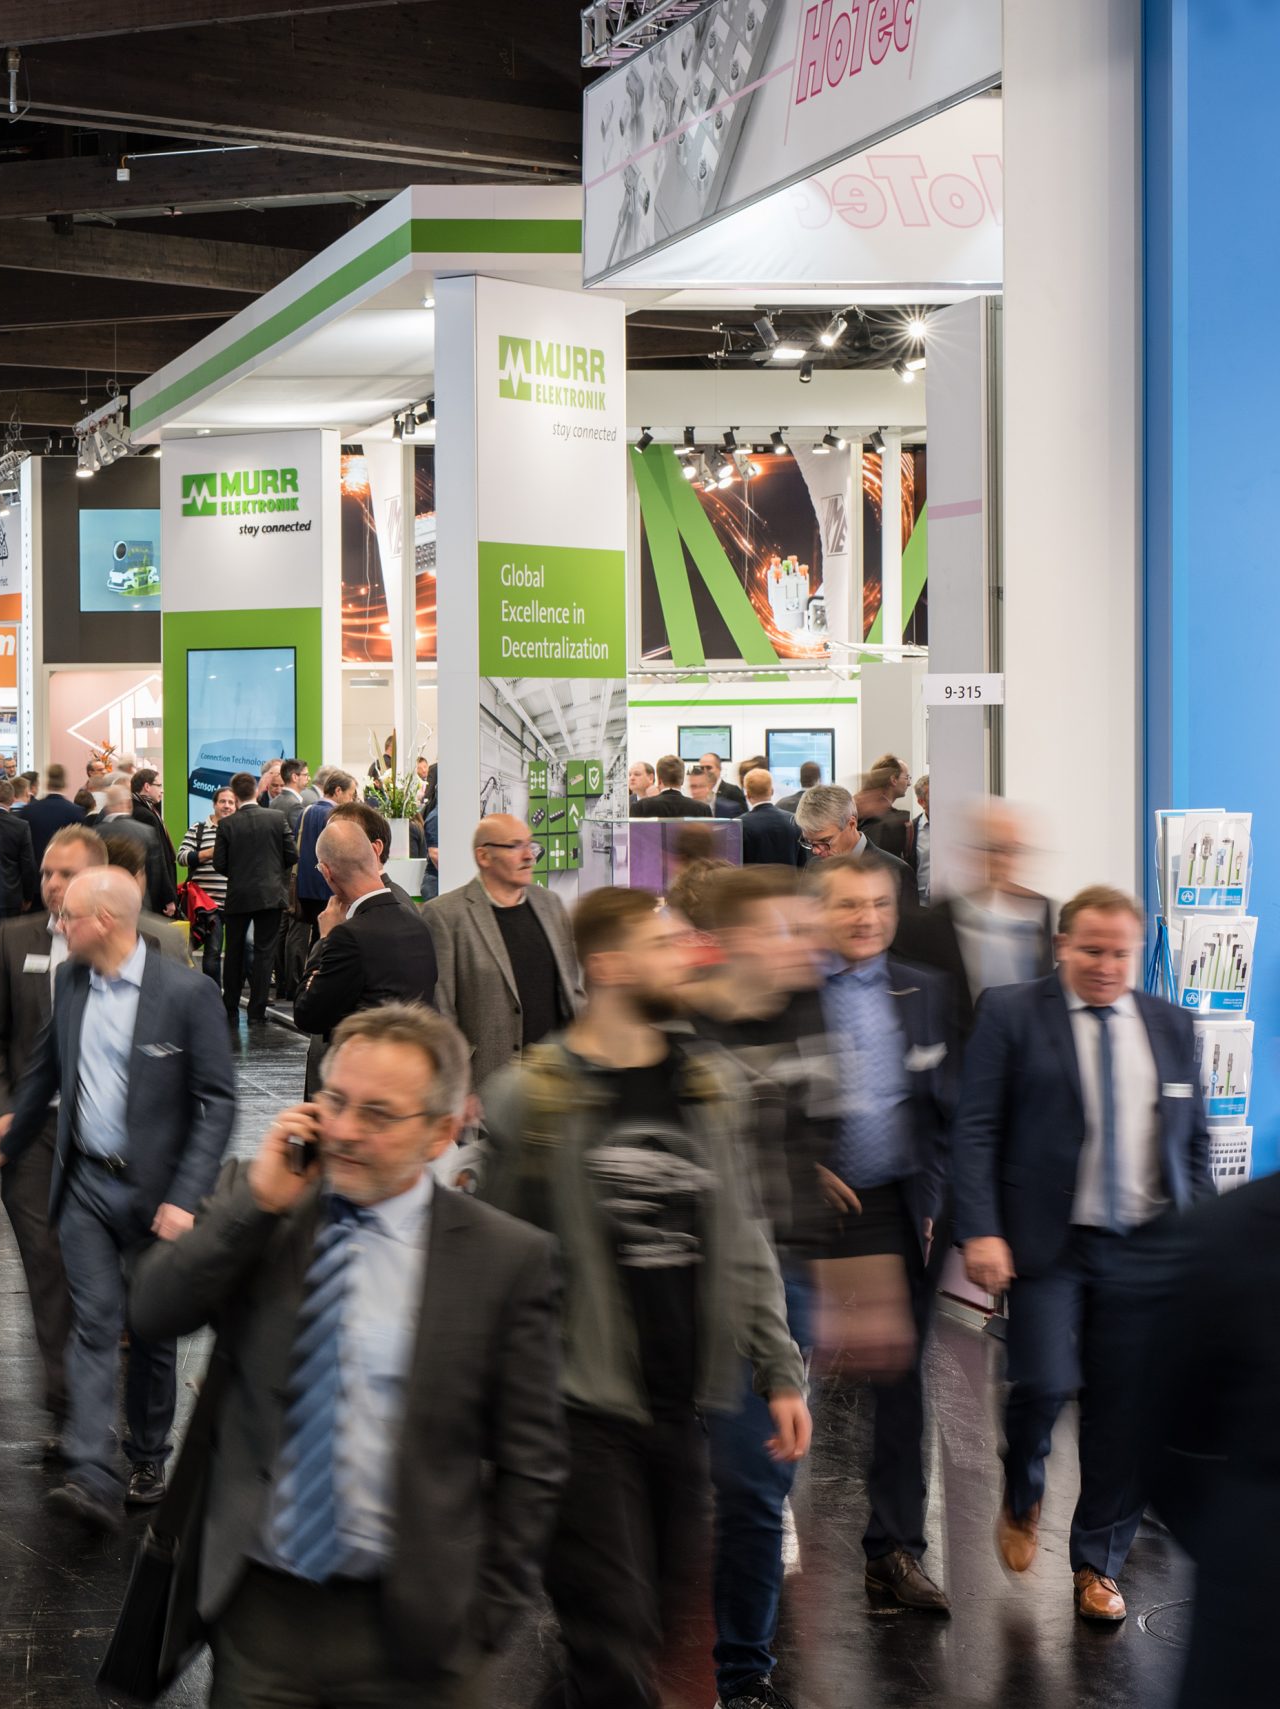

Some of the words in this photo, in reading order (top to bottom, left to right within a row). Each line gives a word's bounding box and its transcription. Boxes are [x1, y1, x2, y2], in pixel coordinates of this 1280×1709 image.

[535, 340, 606, 384] MURR
[535, 383, 606, 411] ELEKTRONIK
[552, 422, 571, 441] stay
[572, 425, 617, 442] connected
[221, 468, 299, 497] MURR
[221, 497, 299, 516] ELEKTRONIK
[239, 524, 260, 538] stay
[261, 520, 312, 533] connected
[501, 564, 545, 589] Global
[501, 600, 570, 624] Excellence
[573, 602, 585, 625] in
[501, 637, 609, 661] Decentralization
[944, 685, 982, 699] 9-315
[200, 752, 231, 763] Connection
